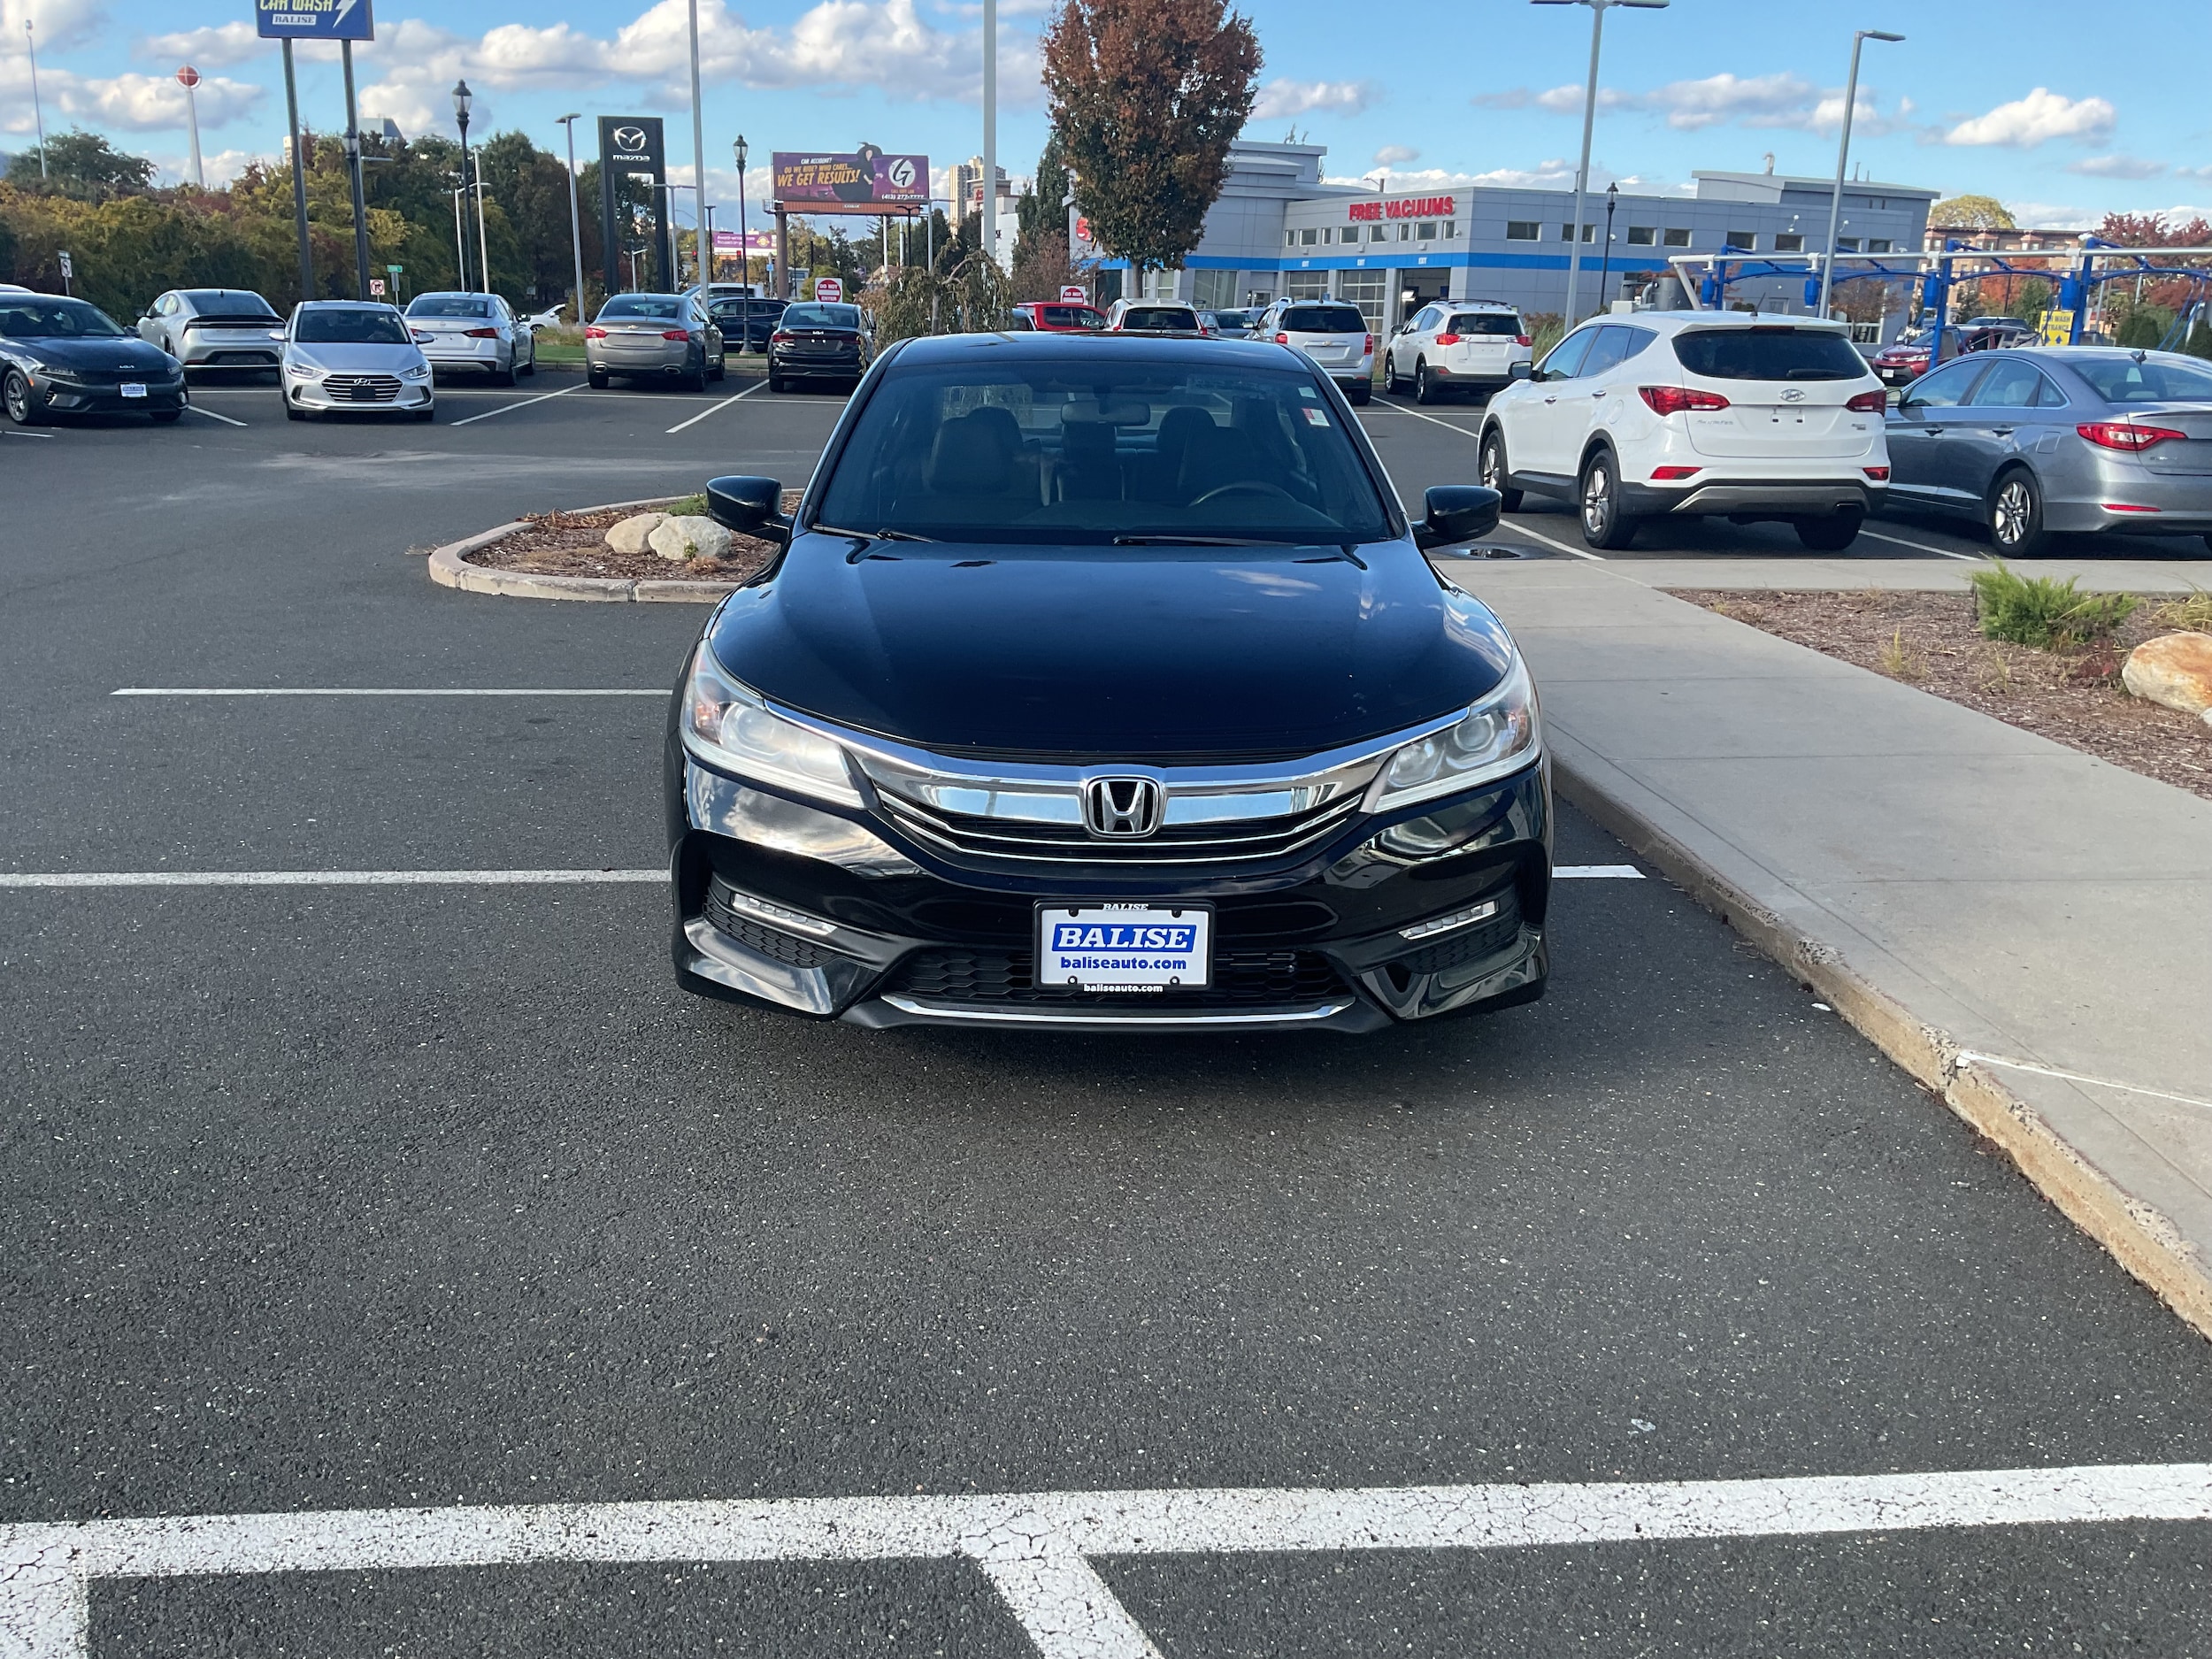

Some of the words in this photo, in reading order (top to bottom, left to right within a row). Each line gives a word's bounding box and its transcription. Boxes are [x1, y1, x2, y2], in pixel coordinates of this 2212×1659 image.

[259, 0, 288, 11] CAR
[292, 0, 333, 12] WASH
[274, 15, 314, 24] BALISE
[778, 173, 794, 187] WE
[796, 172, 815, 187] GET
[817, 169, 861, 185] RESULTS!
[1348, 203, 1381, 220] FREE
[1384, 196, 1455, 219] VACUUMS
[1058, 927, 1191, 949] BALISE
[1060, 956, 1187, 970] baliseauto.com
[1083, 984, 1164, 993] baliseauto.com
